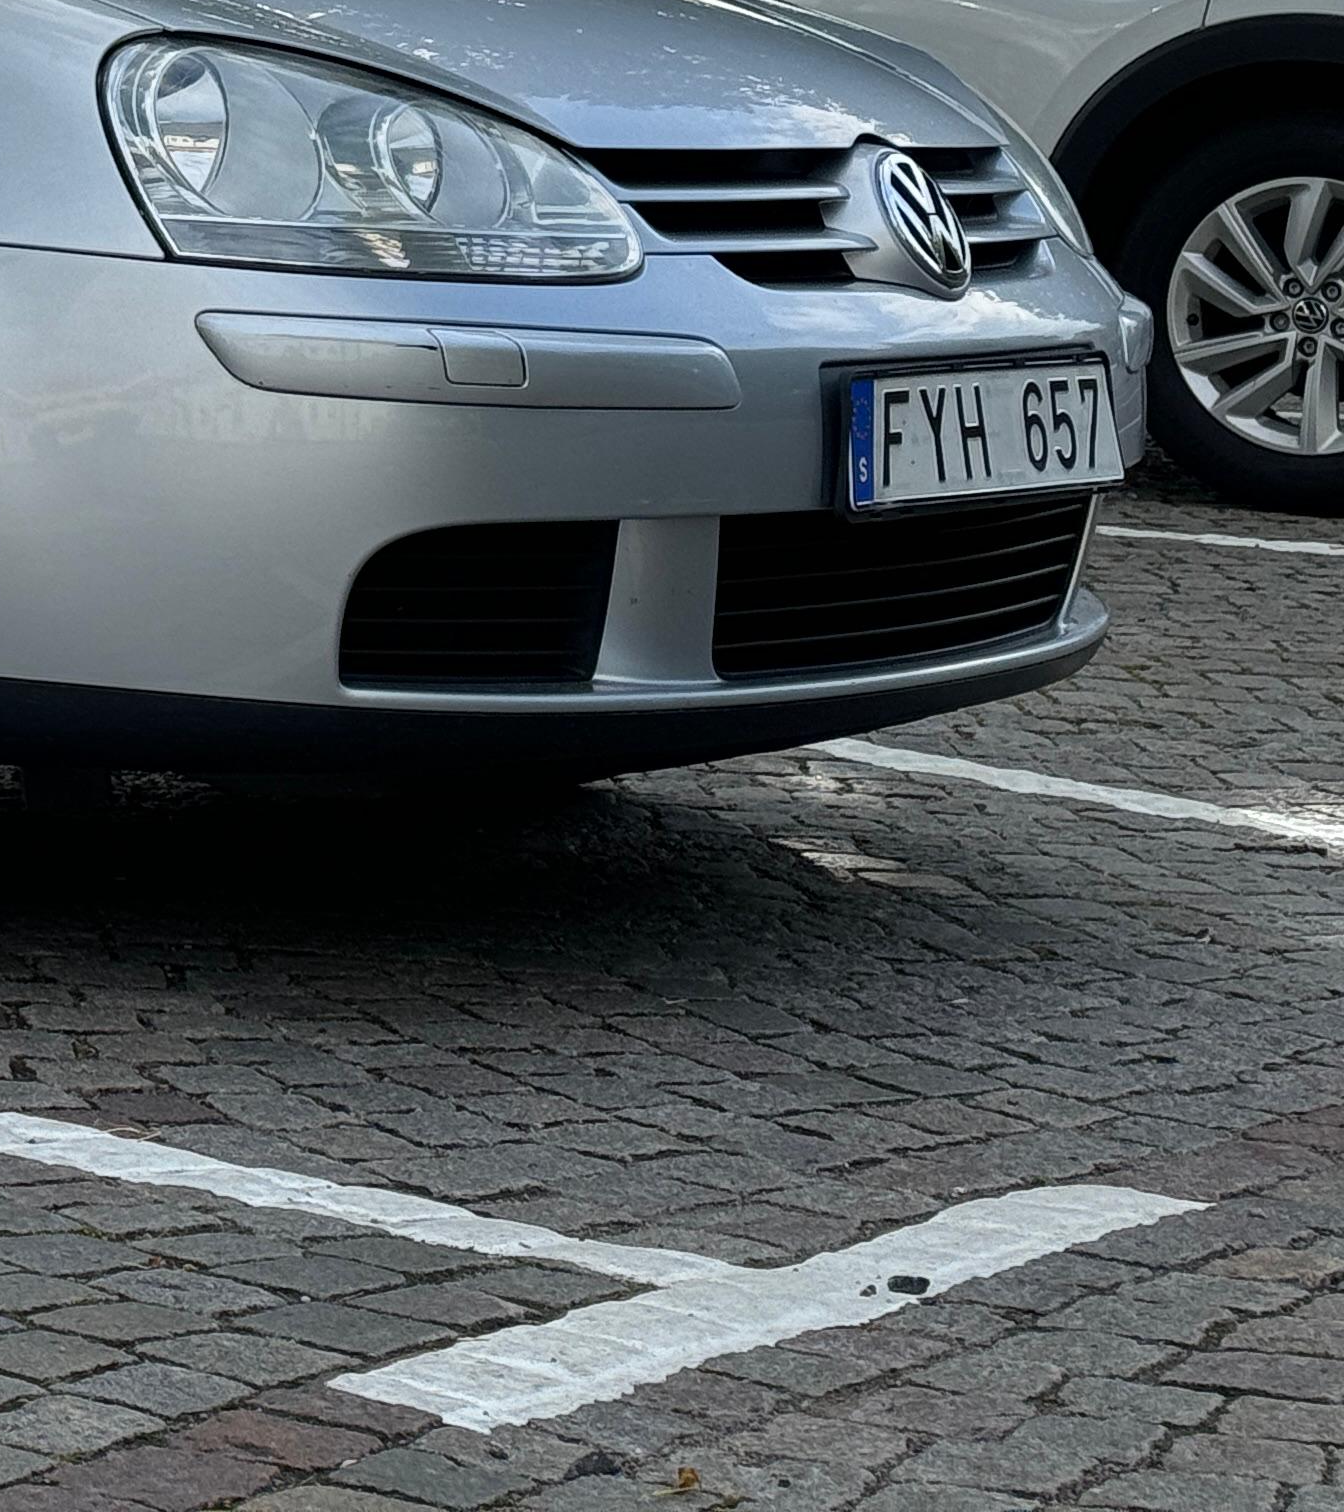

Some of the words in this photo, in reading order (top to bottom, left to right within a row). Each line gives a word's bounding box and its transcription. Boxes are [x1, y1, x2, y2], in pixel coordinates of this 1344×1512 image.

[858, 456, 869, 483] S
[881, 385, 992, 488] FYH
[1022, 377, 1099, 472] 657
